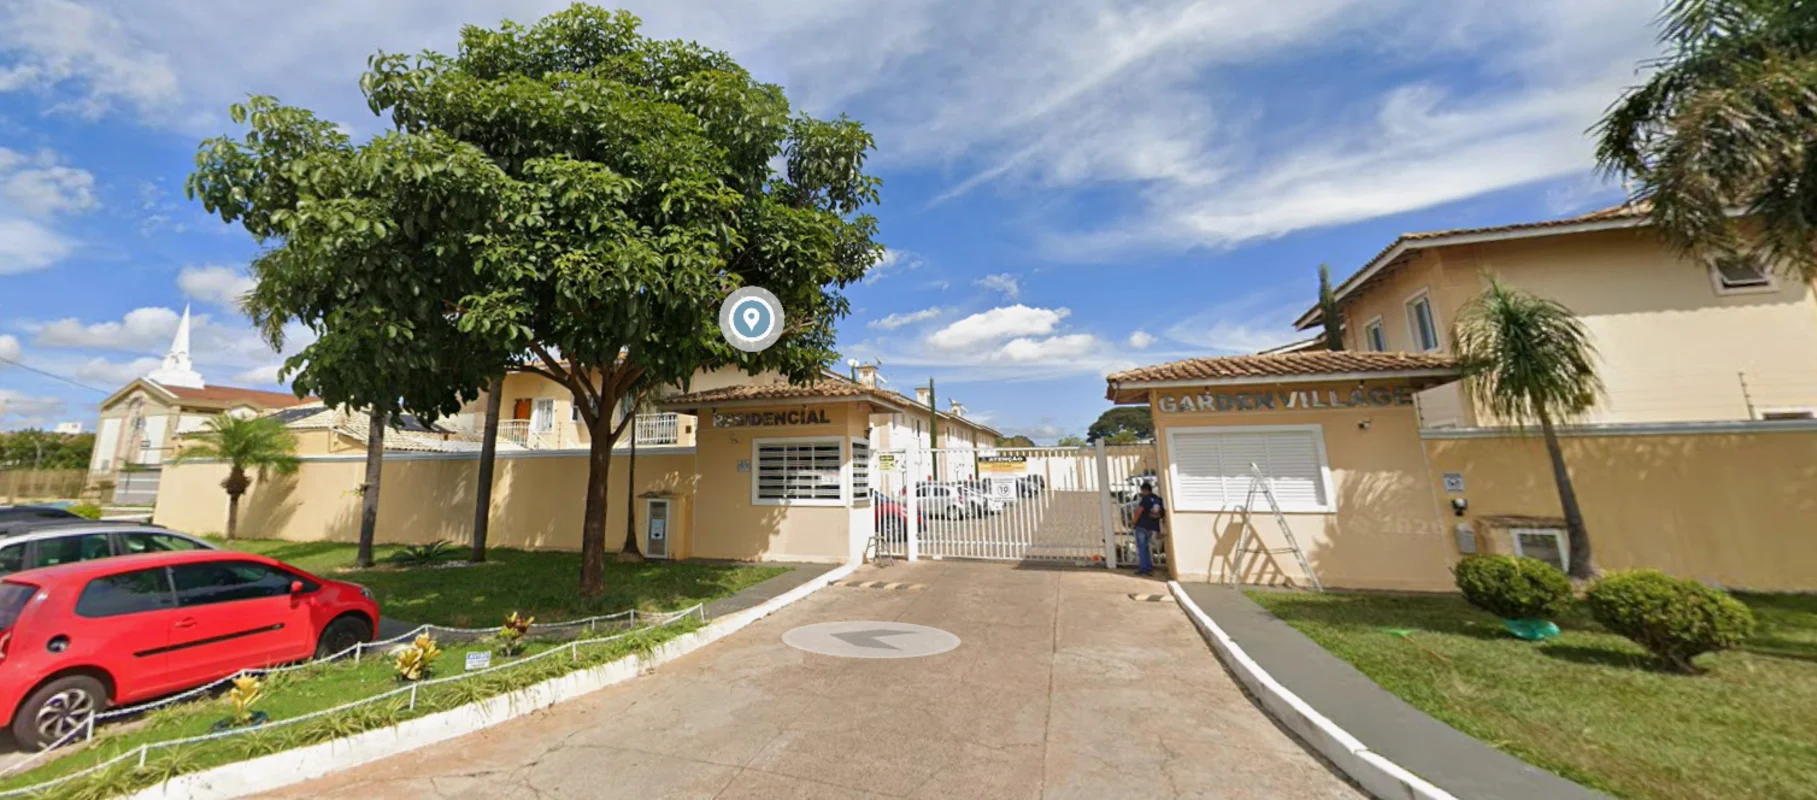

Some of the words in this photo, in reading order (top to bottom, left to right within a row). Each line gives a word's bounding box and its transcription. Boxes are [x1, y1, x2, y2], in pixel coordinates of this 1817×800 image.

[1158, 393, 1275, 413] GARDEN
[1277, 386, 1411, 409] VILLAGE
[713, 410, 830, 428] RESIDENCIAL
